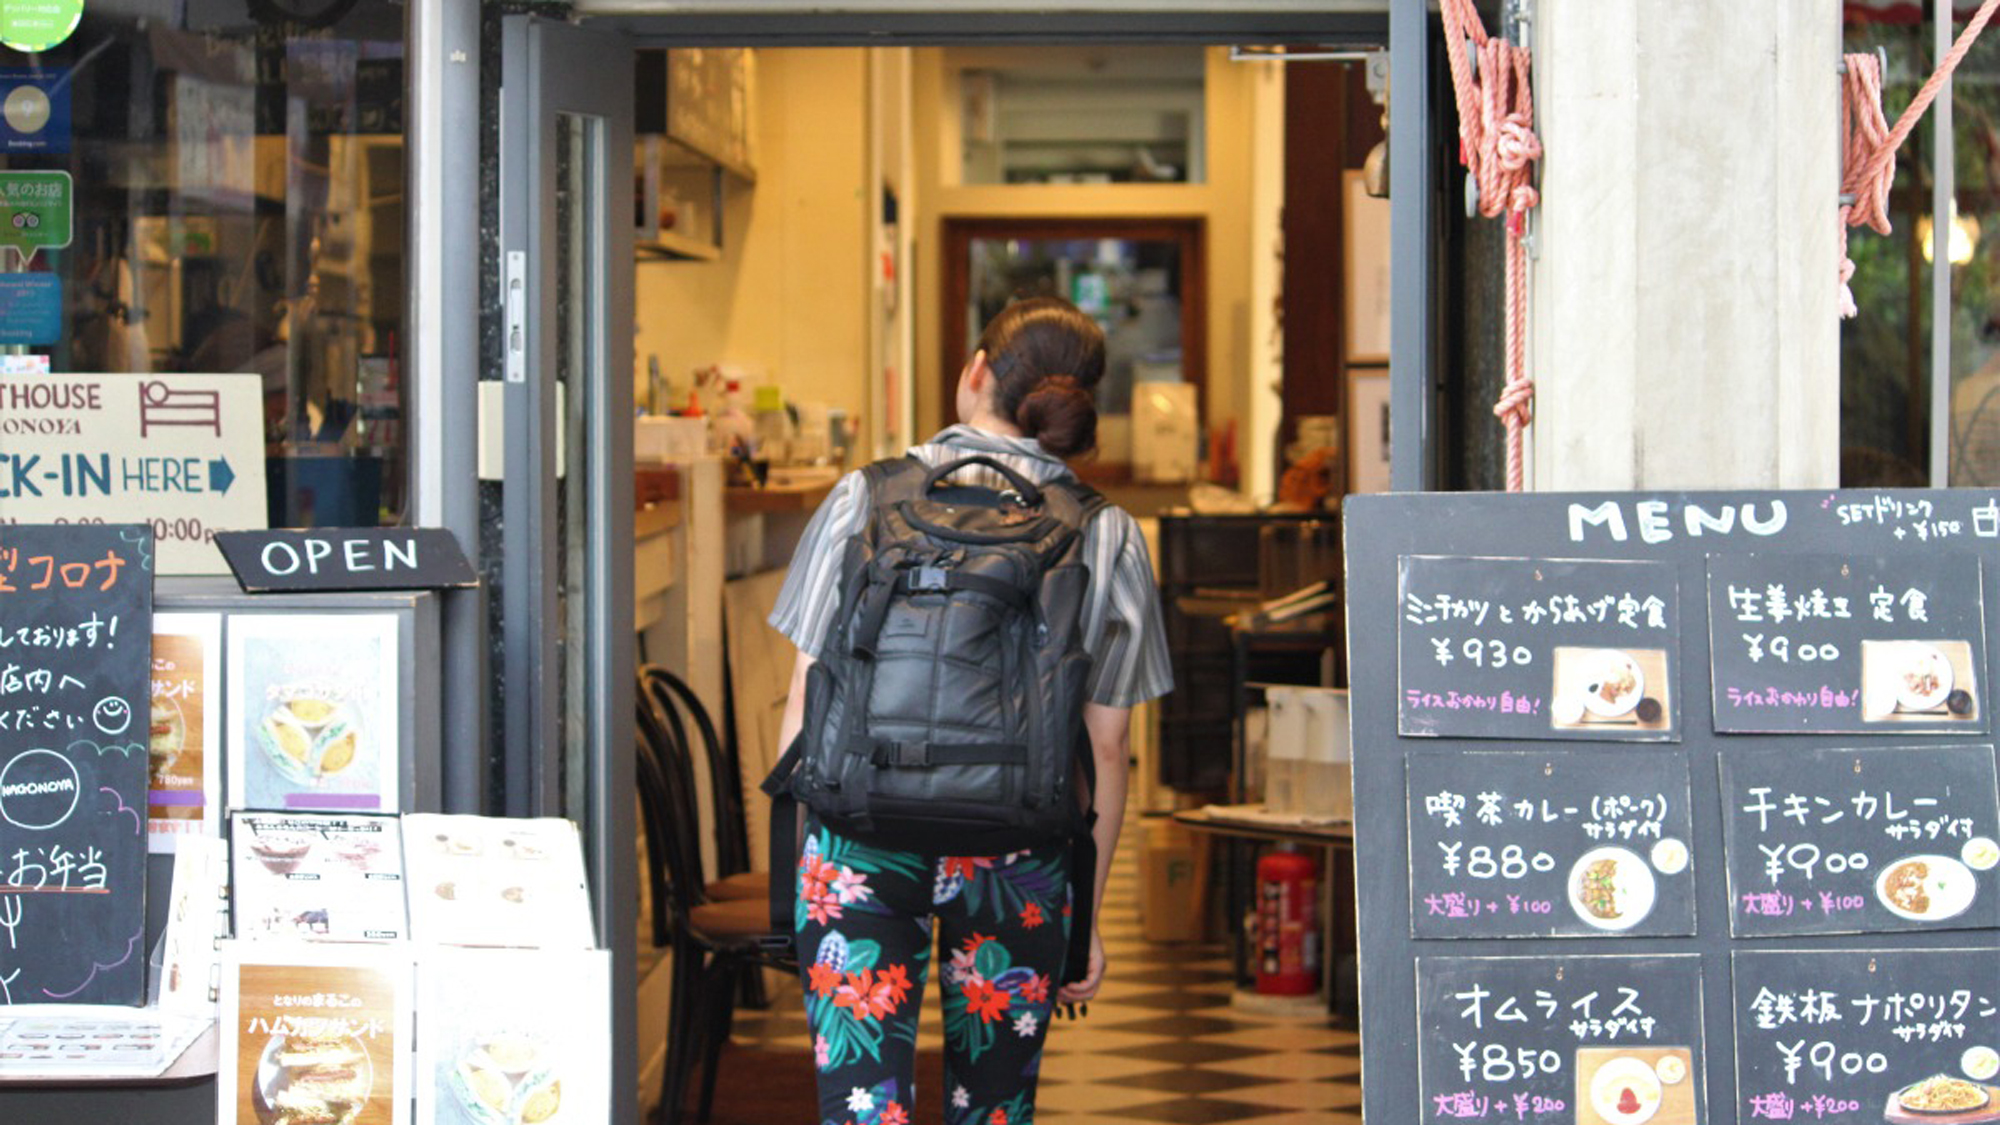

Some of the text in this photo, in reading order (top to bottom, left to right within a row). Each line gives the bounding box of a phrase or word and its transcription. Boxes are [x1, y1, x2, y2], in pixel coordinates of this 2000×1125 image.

[3, 418, 81, 435] ONOYA
[122, 457, 203, 492] HERE
[1568, 500, 1788, 544] MENU
[261, 539, 417, 575] OPEN
[1431, 638, 1532, 667] ¥930
[1742, 633, 1840, 662] ¥900
[1, 663, 86, 694] 店内へ
[0, 705, 84, 730] ください
[2, 778, 74, 797] NAGONOYA
[1743, 787, 1937, 832] チキンカレー
[0, 844, 107, 892] お弁当
[1438, 841, 1555, 879] ¥880
[1758, 843, 1869, 886] ¥900
[1455, 983, 1642, 1029] オムライス
[1452, 1041, 1561, 1082] ¥850
[1776, 1039, 1888, 1085] ¥900
